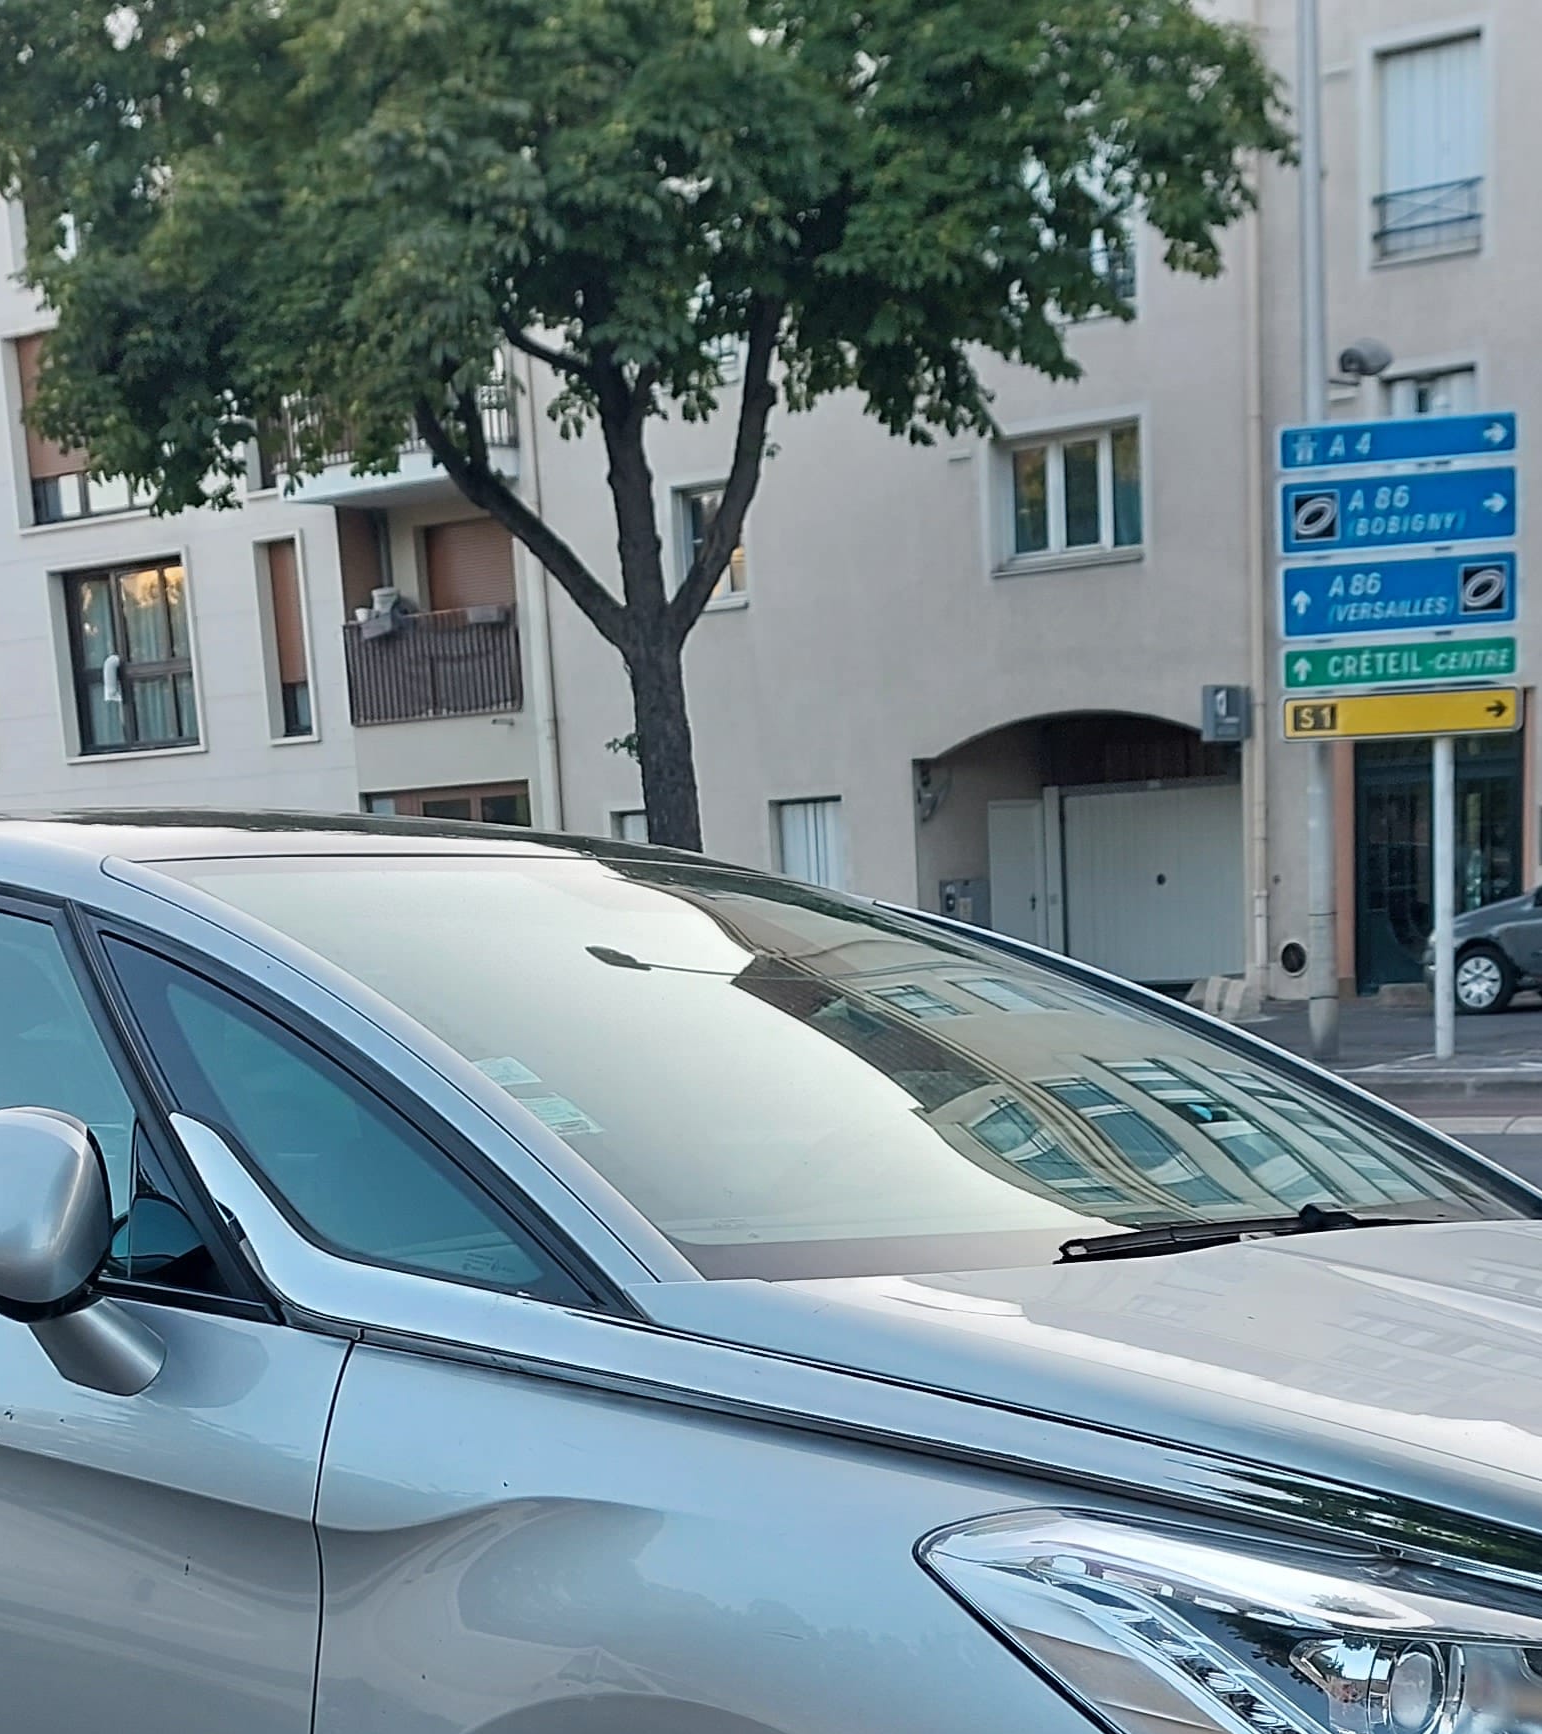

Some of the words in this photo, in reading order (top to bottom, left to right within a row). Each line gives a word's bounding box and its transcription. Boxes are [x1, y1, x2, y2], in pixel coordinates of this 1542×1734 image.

[1328, 433, 1345, 457] A
[1355, 431, 1372, 455] 4
[1348, 489, 1364, 511] A
[1375, 485, 1410, 510] 86
[1300, 708, 1314, 729] S
[1321, 706, 1331, 728] 1
